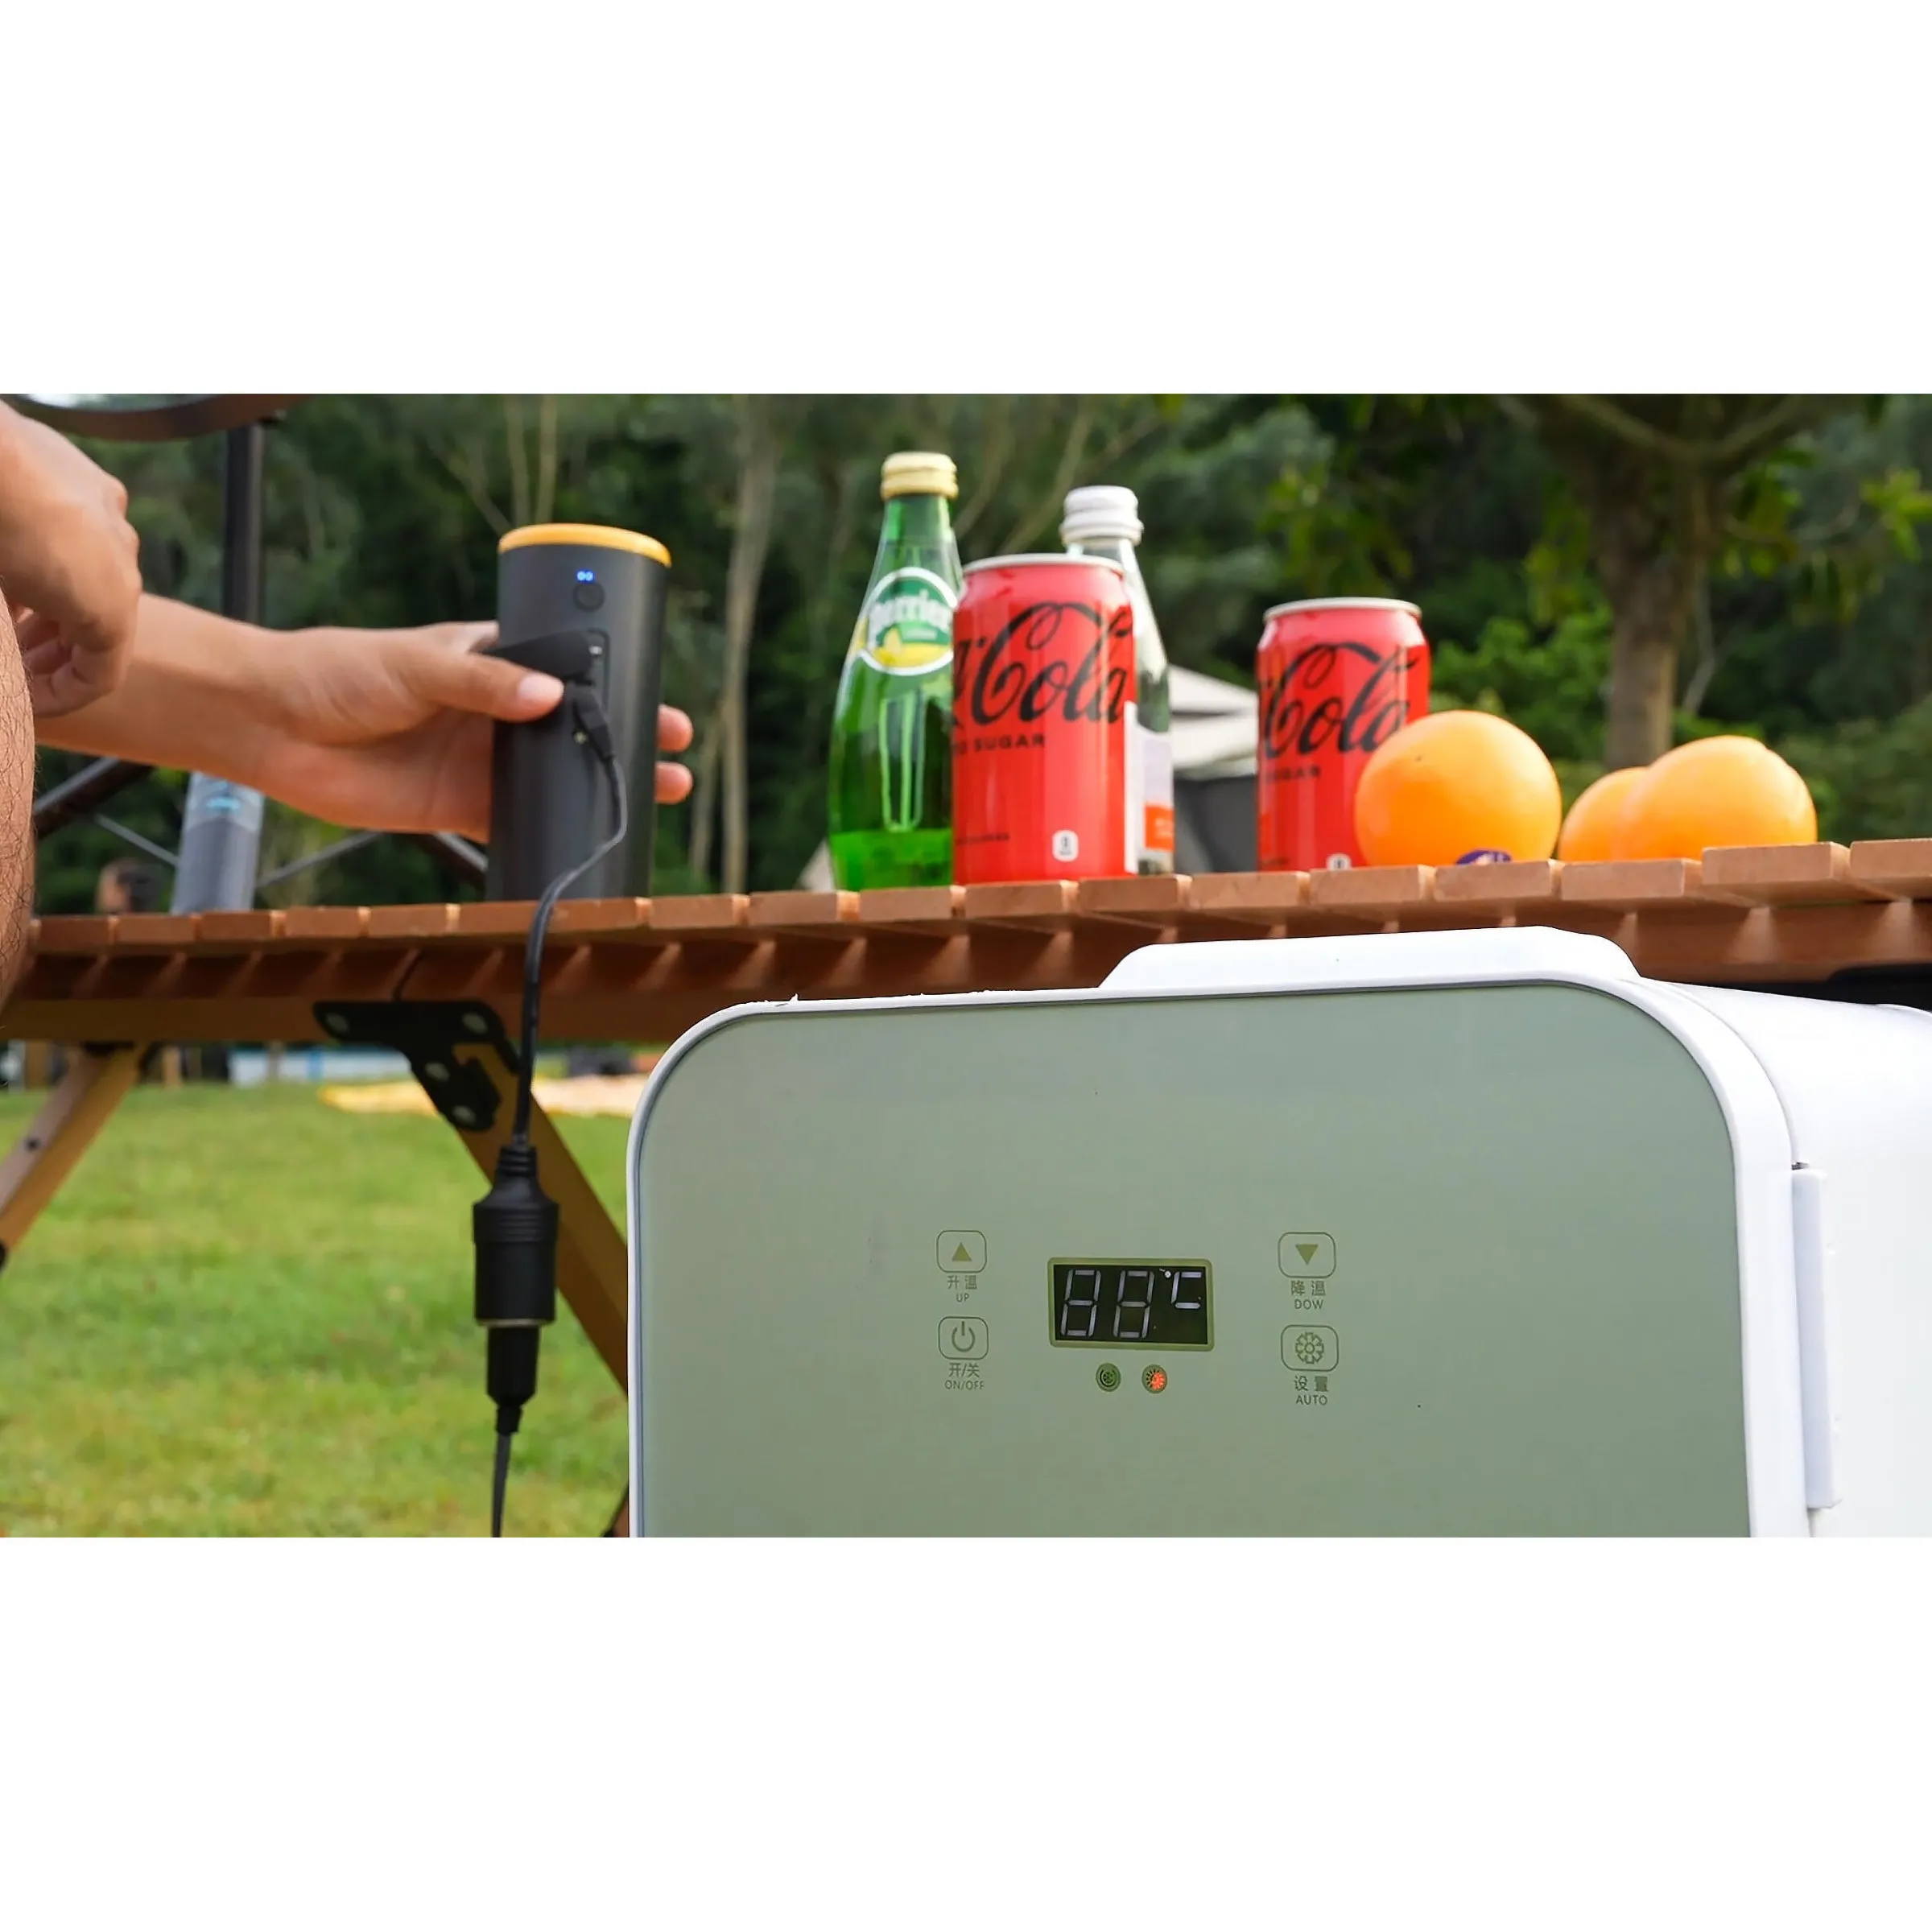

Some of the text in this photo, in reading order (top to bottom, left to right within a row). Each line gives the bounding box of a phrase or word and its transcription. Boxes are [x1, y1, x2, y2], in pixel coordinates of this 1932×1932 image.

[974, 733, 1046, 753] SUGAR
[956, 1293, 970, 1303] UP
[1294, 1298, 1324, 1311] DOW
[947, 1361, 980, 1379] 开/关
[944, 1380, 985, 1391] ON/OFF
[1294, 1394, 1328, 1406] AUTO
